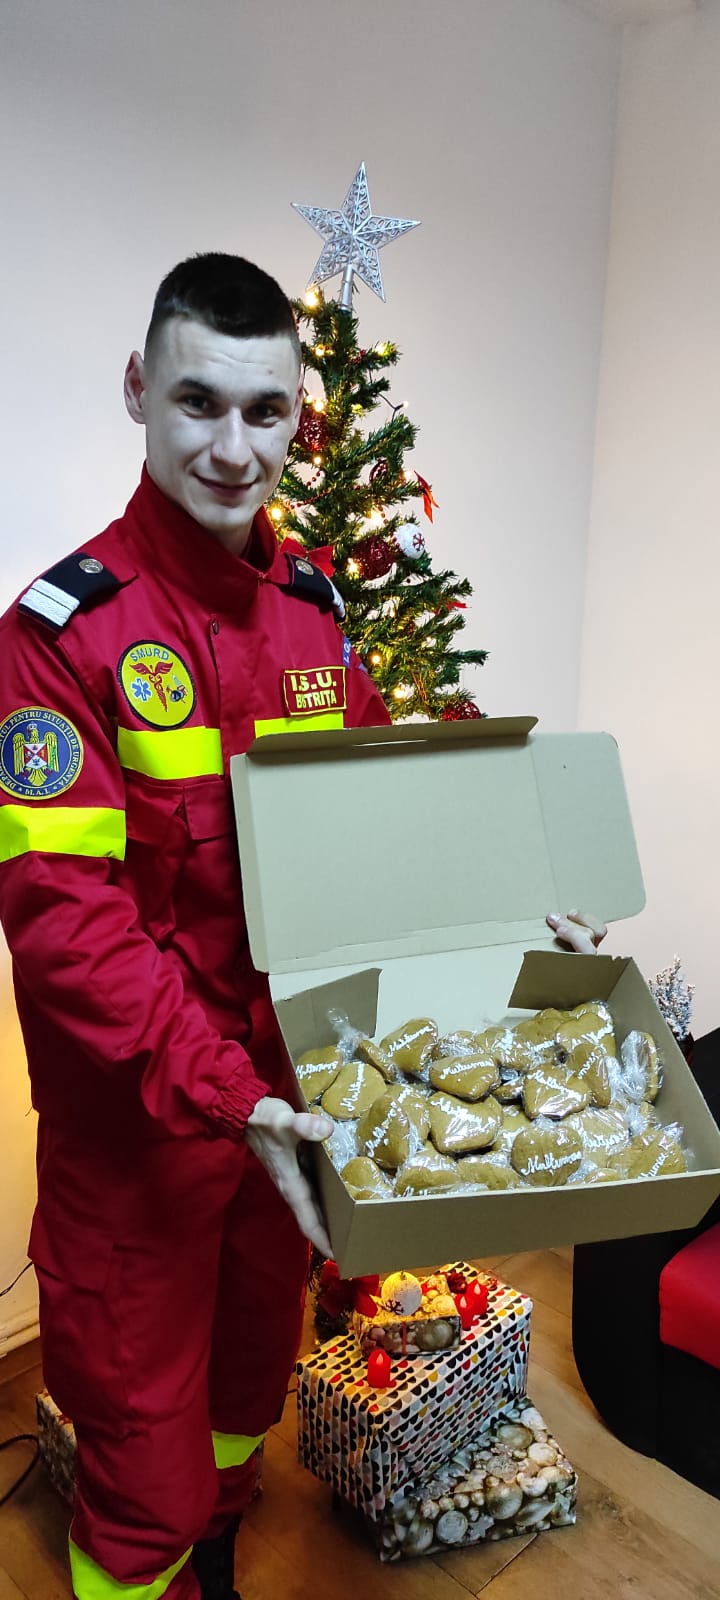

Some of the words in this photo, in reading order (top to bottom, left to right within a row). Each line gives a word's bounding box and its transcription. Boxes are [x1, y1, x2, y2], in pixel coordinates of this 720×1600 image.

[130, 648, 169, 662] SMURD
[11, 711, 41, 726] PENTRU
[70, 739, 79, 750] DE
